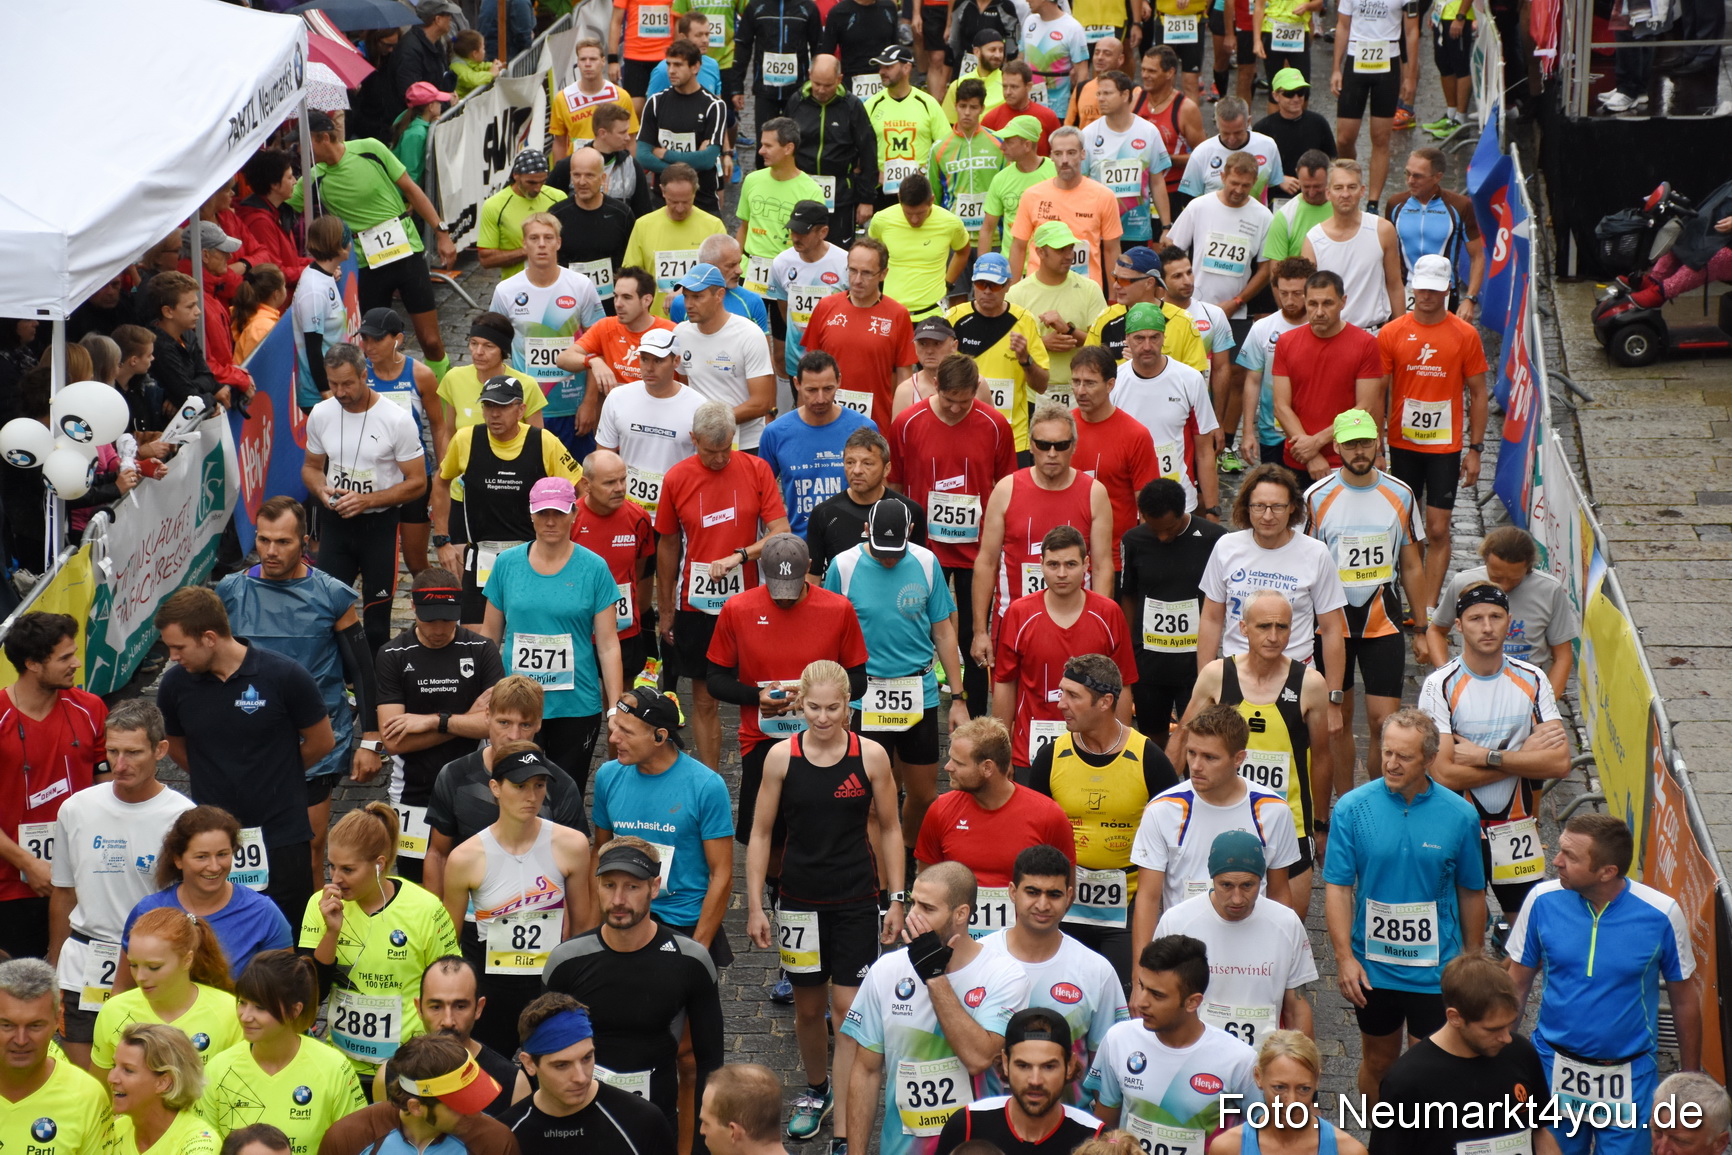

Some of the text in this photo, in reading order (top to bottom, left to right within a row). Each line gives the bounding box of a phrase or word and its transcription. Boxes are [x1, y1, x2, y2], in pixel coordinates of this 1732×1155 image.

[642, 13, 669, 26] 2019
[1168, 20, 1195, 32] 2815
[1362, 48, 1384, 61] 272
[767, 61, 794, 75] 2629
[227, 65, 294, 153] PARTL Neumarkt
[571, 110, 593, 123] MAX
[883, 119, 917, 128] Müller
[892, 137, 907, 151] M
[946, 158, 995, 173] BOCK
[1106, 168, 1139, 183] 2077
[959, 203, 982, 217] 287
[374, 231, 394, 249] 12
[1207, 241, 1245, 263] 2743
[962, 338, 981, 347] Peter
[530, 349, 567, 365] 290
[537, 369, 564, 378] Andreas
[1406, 364, 1443, 372] funrunners
[1416, 370, 1447, 379] neumarkt
[1411, 411, 1442, 428] 297
[1414, 431, 1437, 440] Harald
[240, 420, 272, 501] Hervis
[487, 484, 520, 492] Regensburg
[496, 478, 523, 486] Marathon
[801, 477, 841, 496] PAIN
[629, 478, 658, 501] 293
[933, 504, 976, 525] 2551
[940, 527, 966, 537] Markus
[612, 535, 636, 544] JURA
[1349, 547, 1384, 567] 215
[1355, 570, 1378, 580] Bernd
[695, 575, 740, 596] 2404
[1247, 578, 1297, 592] STIFTUNG
[1154, 613, 1189, 633] 236
[1146, 635, 1198, 648] Girma Ayalew
[518, 648, 567, 671] 2571
[417, 678, 459, 687] LLC Marathon
[528, 674, 557, 687] Sibylle
[420, 686, 457, 695] Regensburg
[235, 699, 266, 708] FIBALON
[875, 689, 912, 711] 355
[877, 715, 908, 724] Thomas
[777, 722, 801, 732] Oliver
[41, 786, 58, 803] DEHN
[834, 788, 866, 798] adidas
[612, 820, 676, 833] www.hasit.de
[1100, 818, 1133, 828] RÖDL
[1662, 807, 1680, 852] CODE
[93, 835, 105, 849] 6.
[1109, 841, 1127, 849] ELIO
[1510, 836, 1534, 861] 22
[1515, 865, 1536, 877] Claus
[491, 890, 557, 918] SCOTT
[1396, 904, 1430, 915] BOCK
[1373, 916, 1432, 942] 2858
[511, 925, 541, 950] 82
[387, 949, 408, 957] Partl
[1384, 945, 1419, 958] Markus
[515, 955, 534, 966] Rita
[358, 972, 394, 982] THE NEXT
[365, 980, 402, 990] 100 YEARS
[1054, 986, 1080, 1000] Hervis
[357, 998, 396, 1008] BOCK
[891, 1003, 913, 1012] PARTL
[334, 1006, 391, 1039] 2881
[344, 1038, 377, 1055] Verena
[920, 1059, 960, 1075] BOCK
[606, 1075, 645, 1087] BOCK
[1124, 1077, 1144, 1087] PARTL
[1194, 1078, 1221, 1091] Hervis
[1561, 1067, 1624, 1099] 2610
[906, 1078, 956, 1109] 332
[1124, 1084, 1144, 1092] Neumarkt
[289, 1108, 312, 1116] Partl
[543, 1127, 584, 1140] uhlsport
[1157, 1128, 1198, 1140] BOCK
[1495, 1135, 1528, 1150] BOCK
